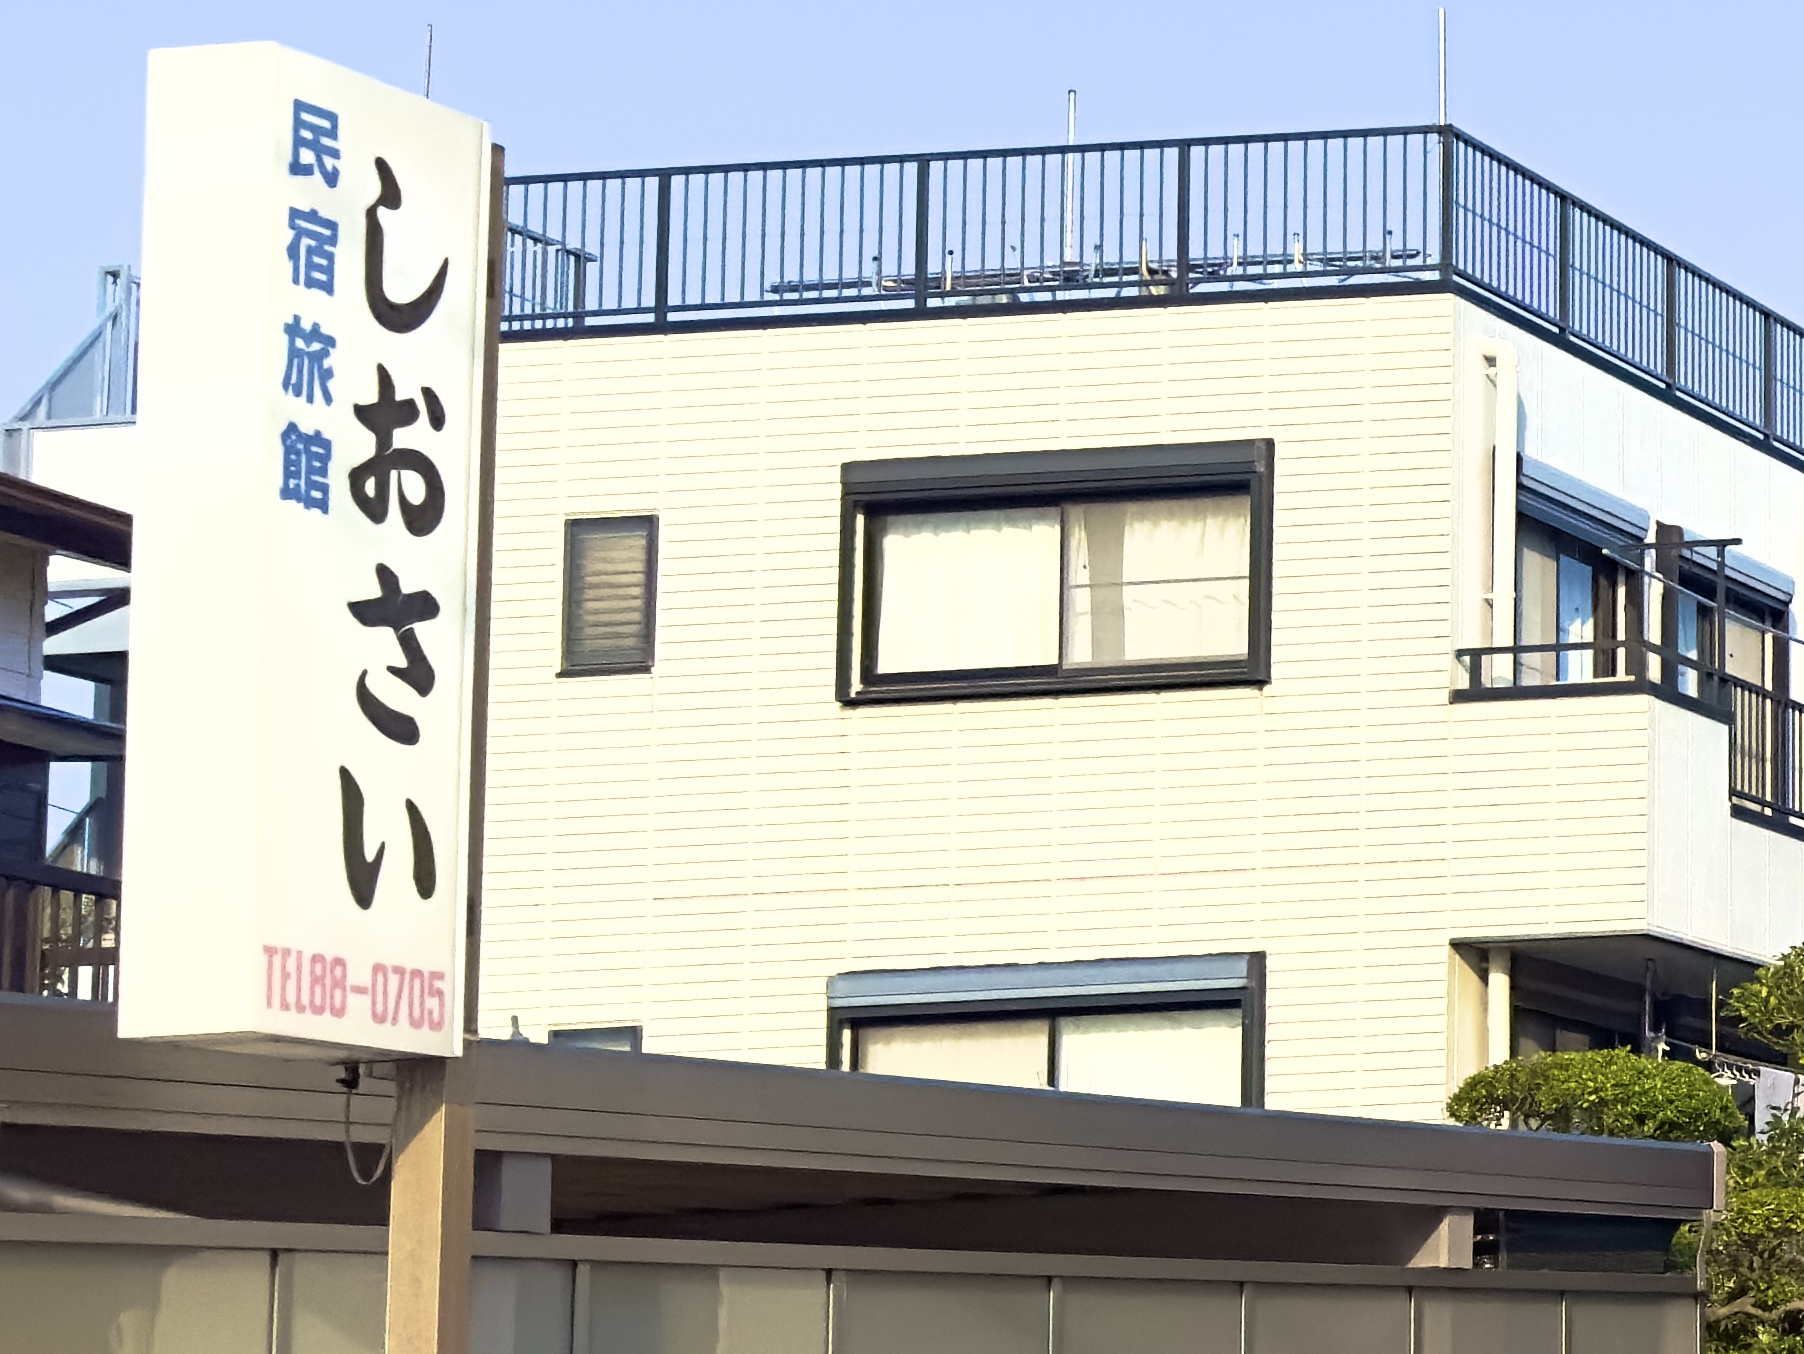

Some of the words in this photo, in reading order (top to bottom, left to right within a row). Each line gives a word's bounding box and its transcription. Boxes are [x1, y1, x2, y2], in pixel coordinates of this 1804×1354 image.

[280, 98, 341, 515] 民宿旅館
[340, 155, 449, 912] しおさい
